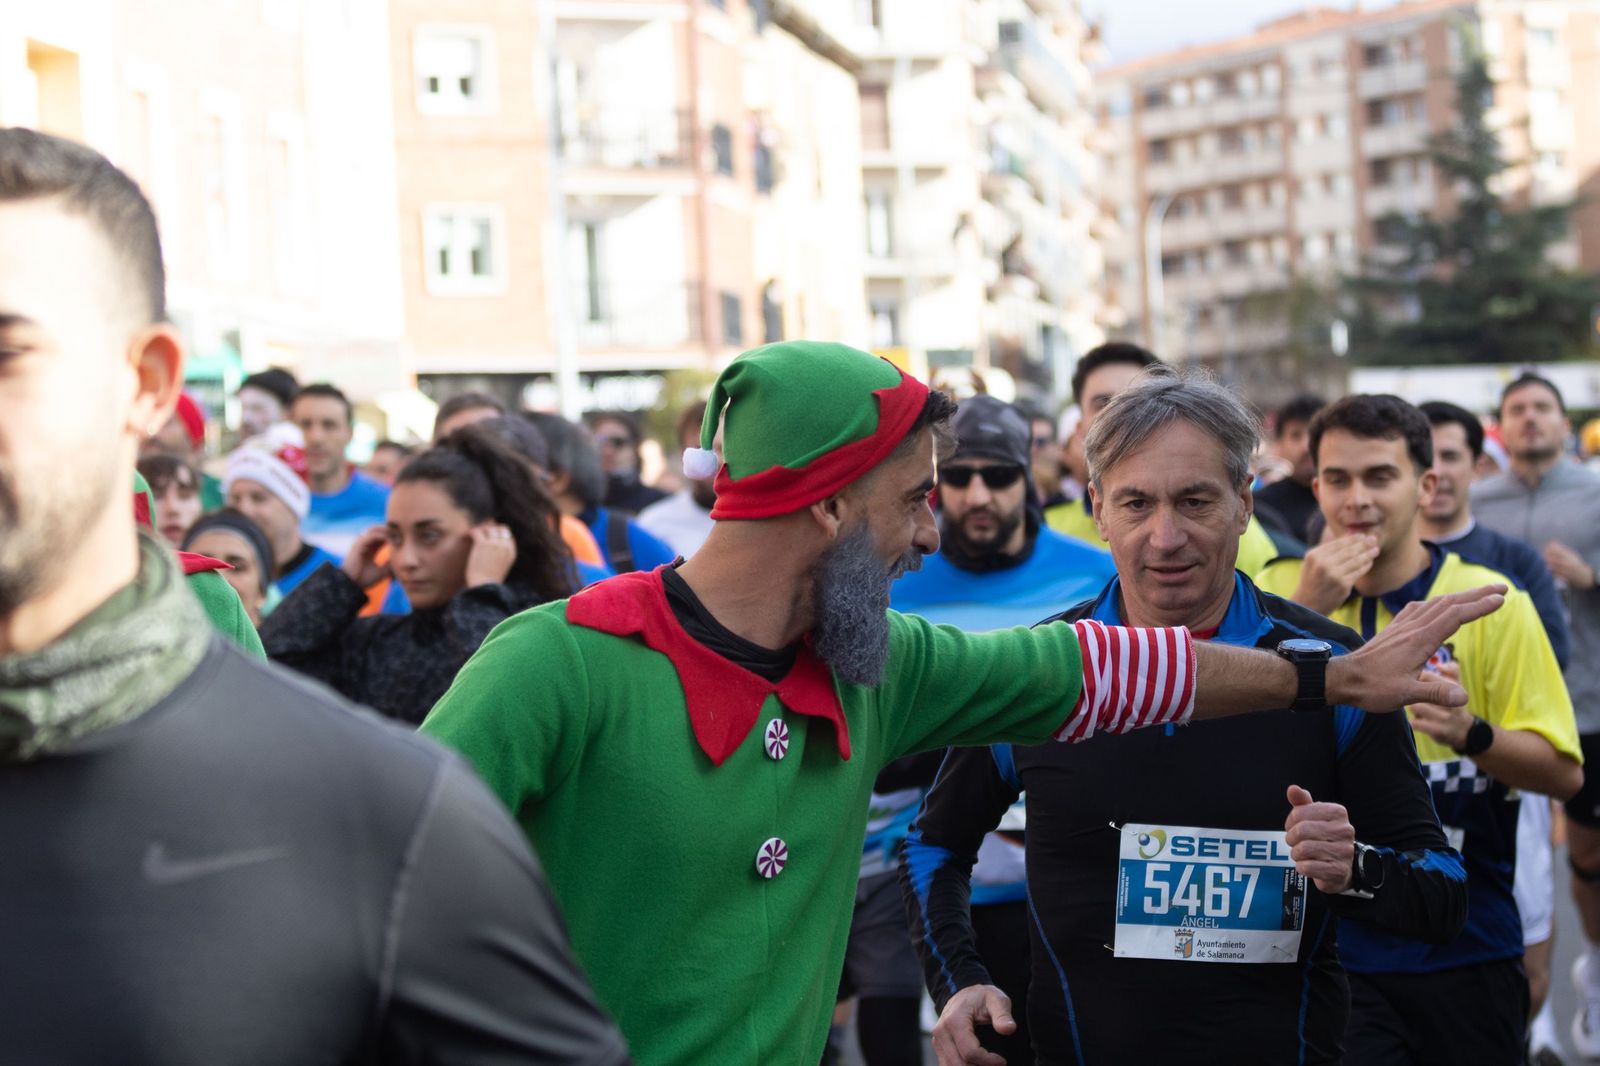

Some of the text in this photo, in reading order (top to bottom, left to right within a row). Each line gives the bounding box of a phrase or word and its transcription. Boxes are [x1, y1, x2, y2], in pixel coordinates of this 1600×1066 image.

[1171, 836, 1289, 860] SETEL
[1143, 862, 1261, 919] 5467
[1180, 915, 1219, 929] ÁNGEL
[1196, 939, 1246, 949] Ayuntamiento
[1196, 950, 1245, 959] de Salamanca
